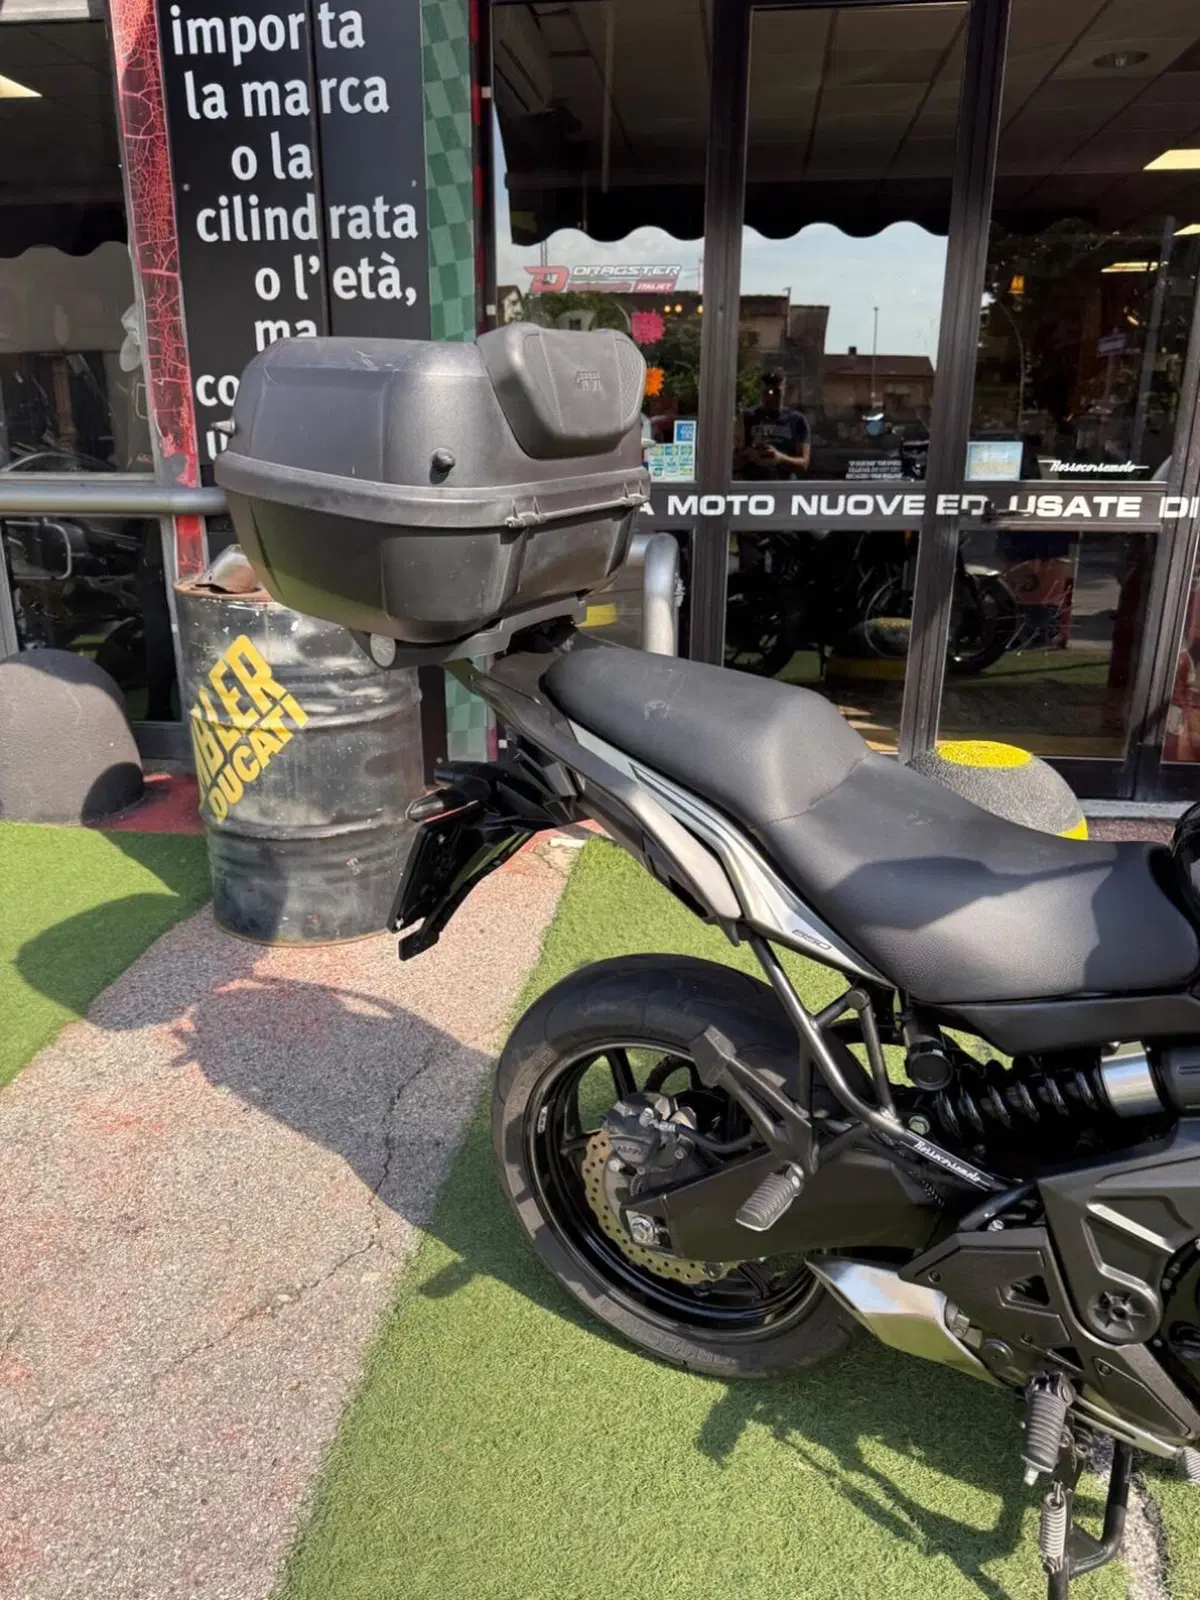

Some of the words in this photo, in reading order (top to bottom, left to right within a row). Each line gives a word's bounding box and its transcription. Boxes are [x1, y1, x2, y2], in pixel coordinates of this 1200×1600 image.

[184, 71, 228, 120] la
[231, 146, 257, 181] o
[271, 131, 313, 180] la
[255, 266, 280, 300] o
[572, 264, 682, 278] DRAGSTER
[667, 494, 775, 516] MOTO
[790, 494, 926, 517] NUOVE
[936, 494, 989, 515] ED
[1008, 495, 1142, 518] USATE
